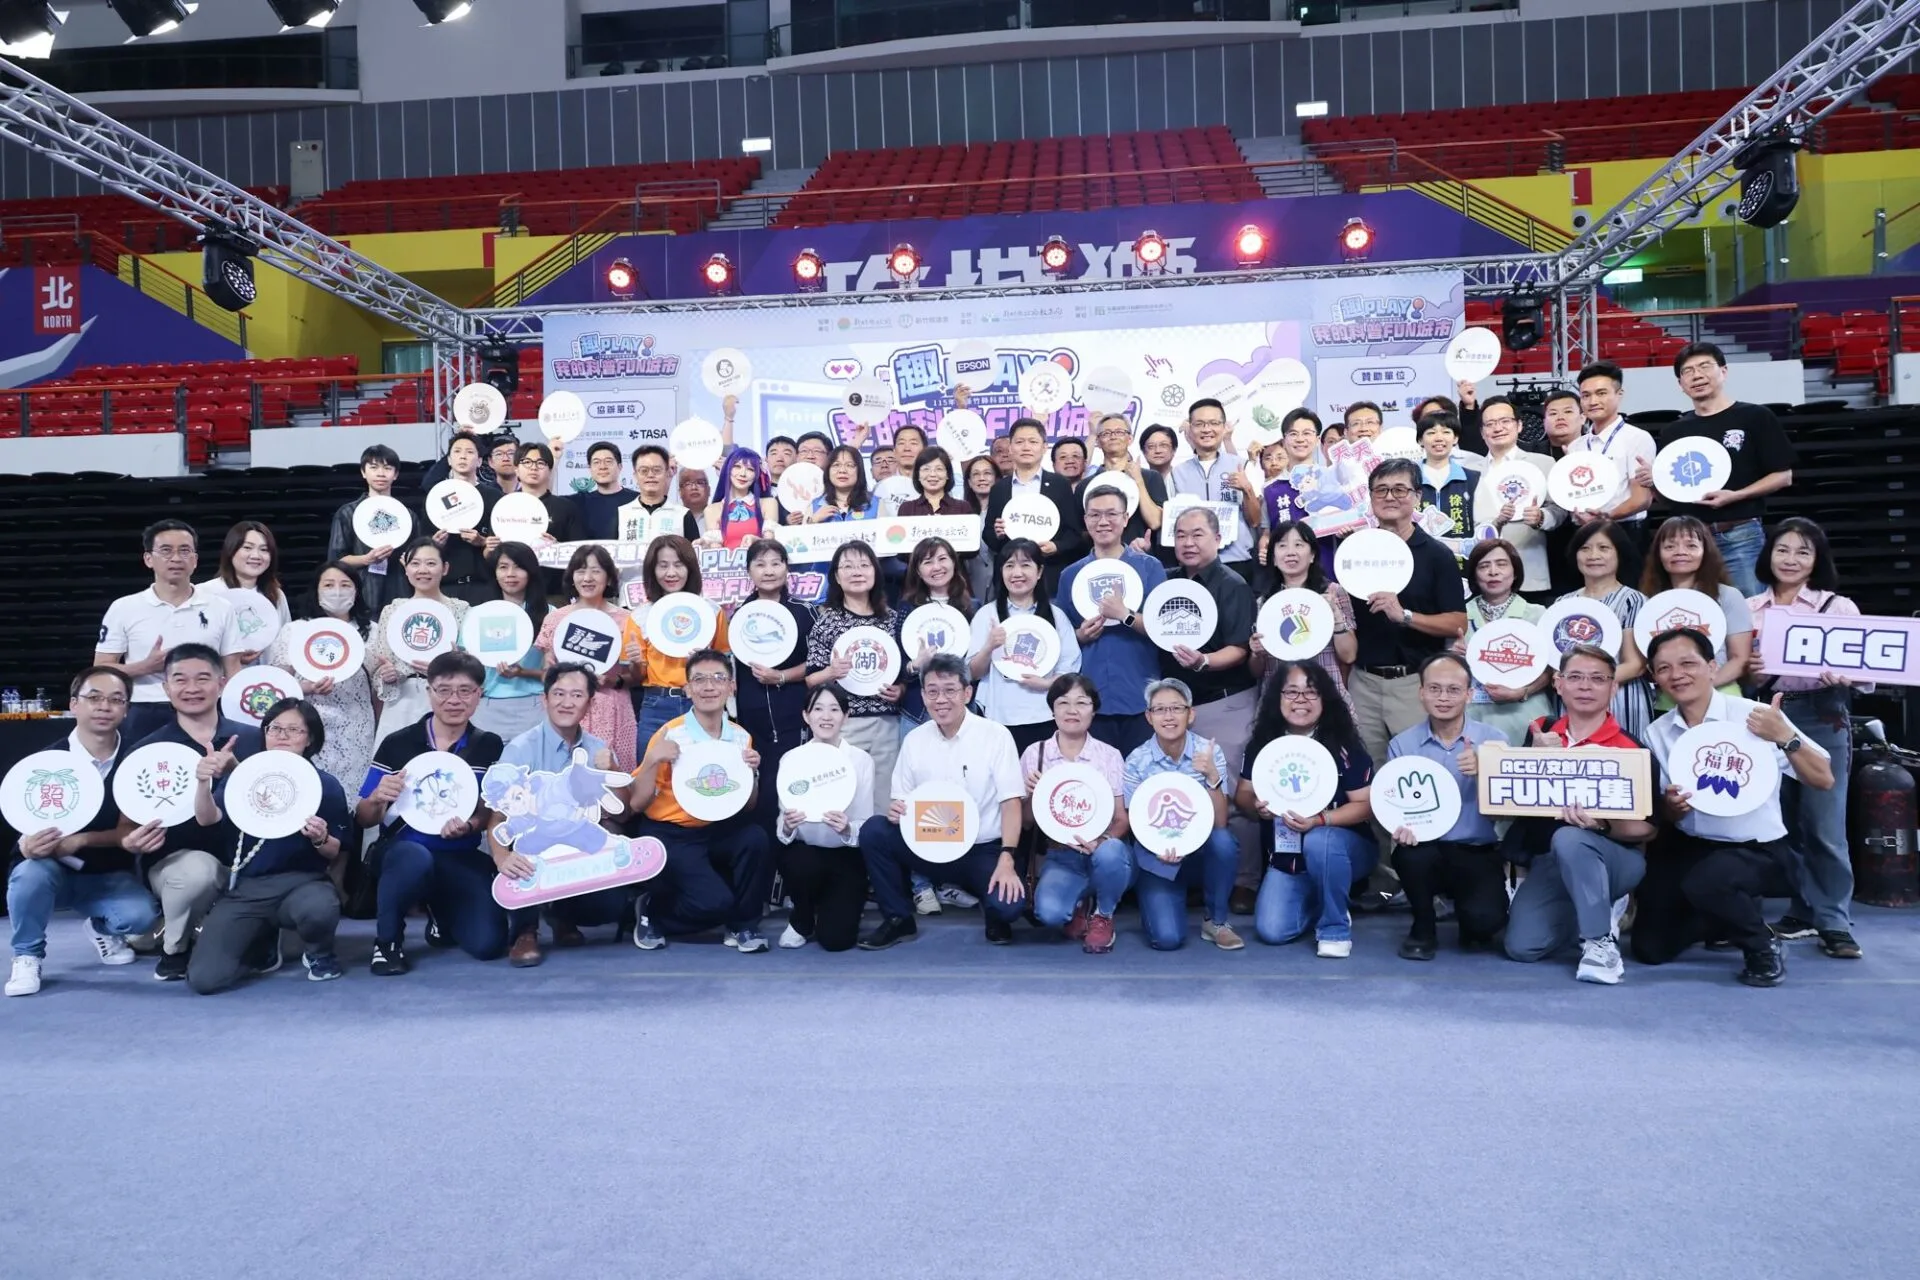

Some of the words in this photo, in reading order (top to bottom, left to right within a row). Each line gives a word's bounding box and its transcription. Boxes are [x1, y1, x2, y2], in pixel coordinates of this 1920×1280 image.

[42, 276, 73, 310] 北
[43, 315, 72, 328] NORTH
[957, 360, 989, 371] EPSON
[640, 428, 668, 439] TASA
[1022, 514, 1052, 527] TASA
[1091, 577, 1122, 587] TCHS
[1783, 624, 1908, 672] ACG
[855, 651, 877, 670] 湖
[1704, 751, 1745, 774] 福興
[1488, 776, 1634, 811] FUN市集
